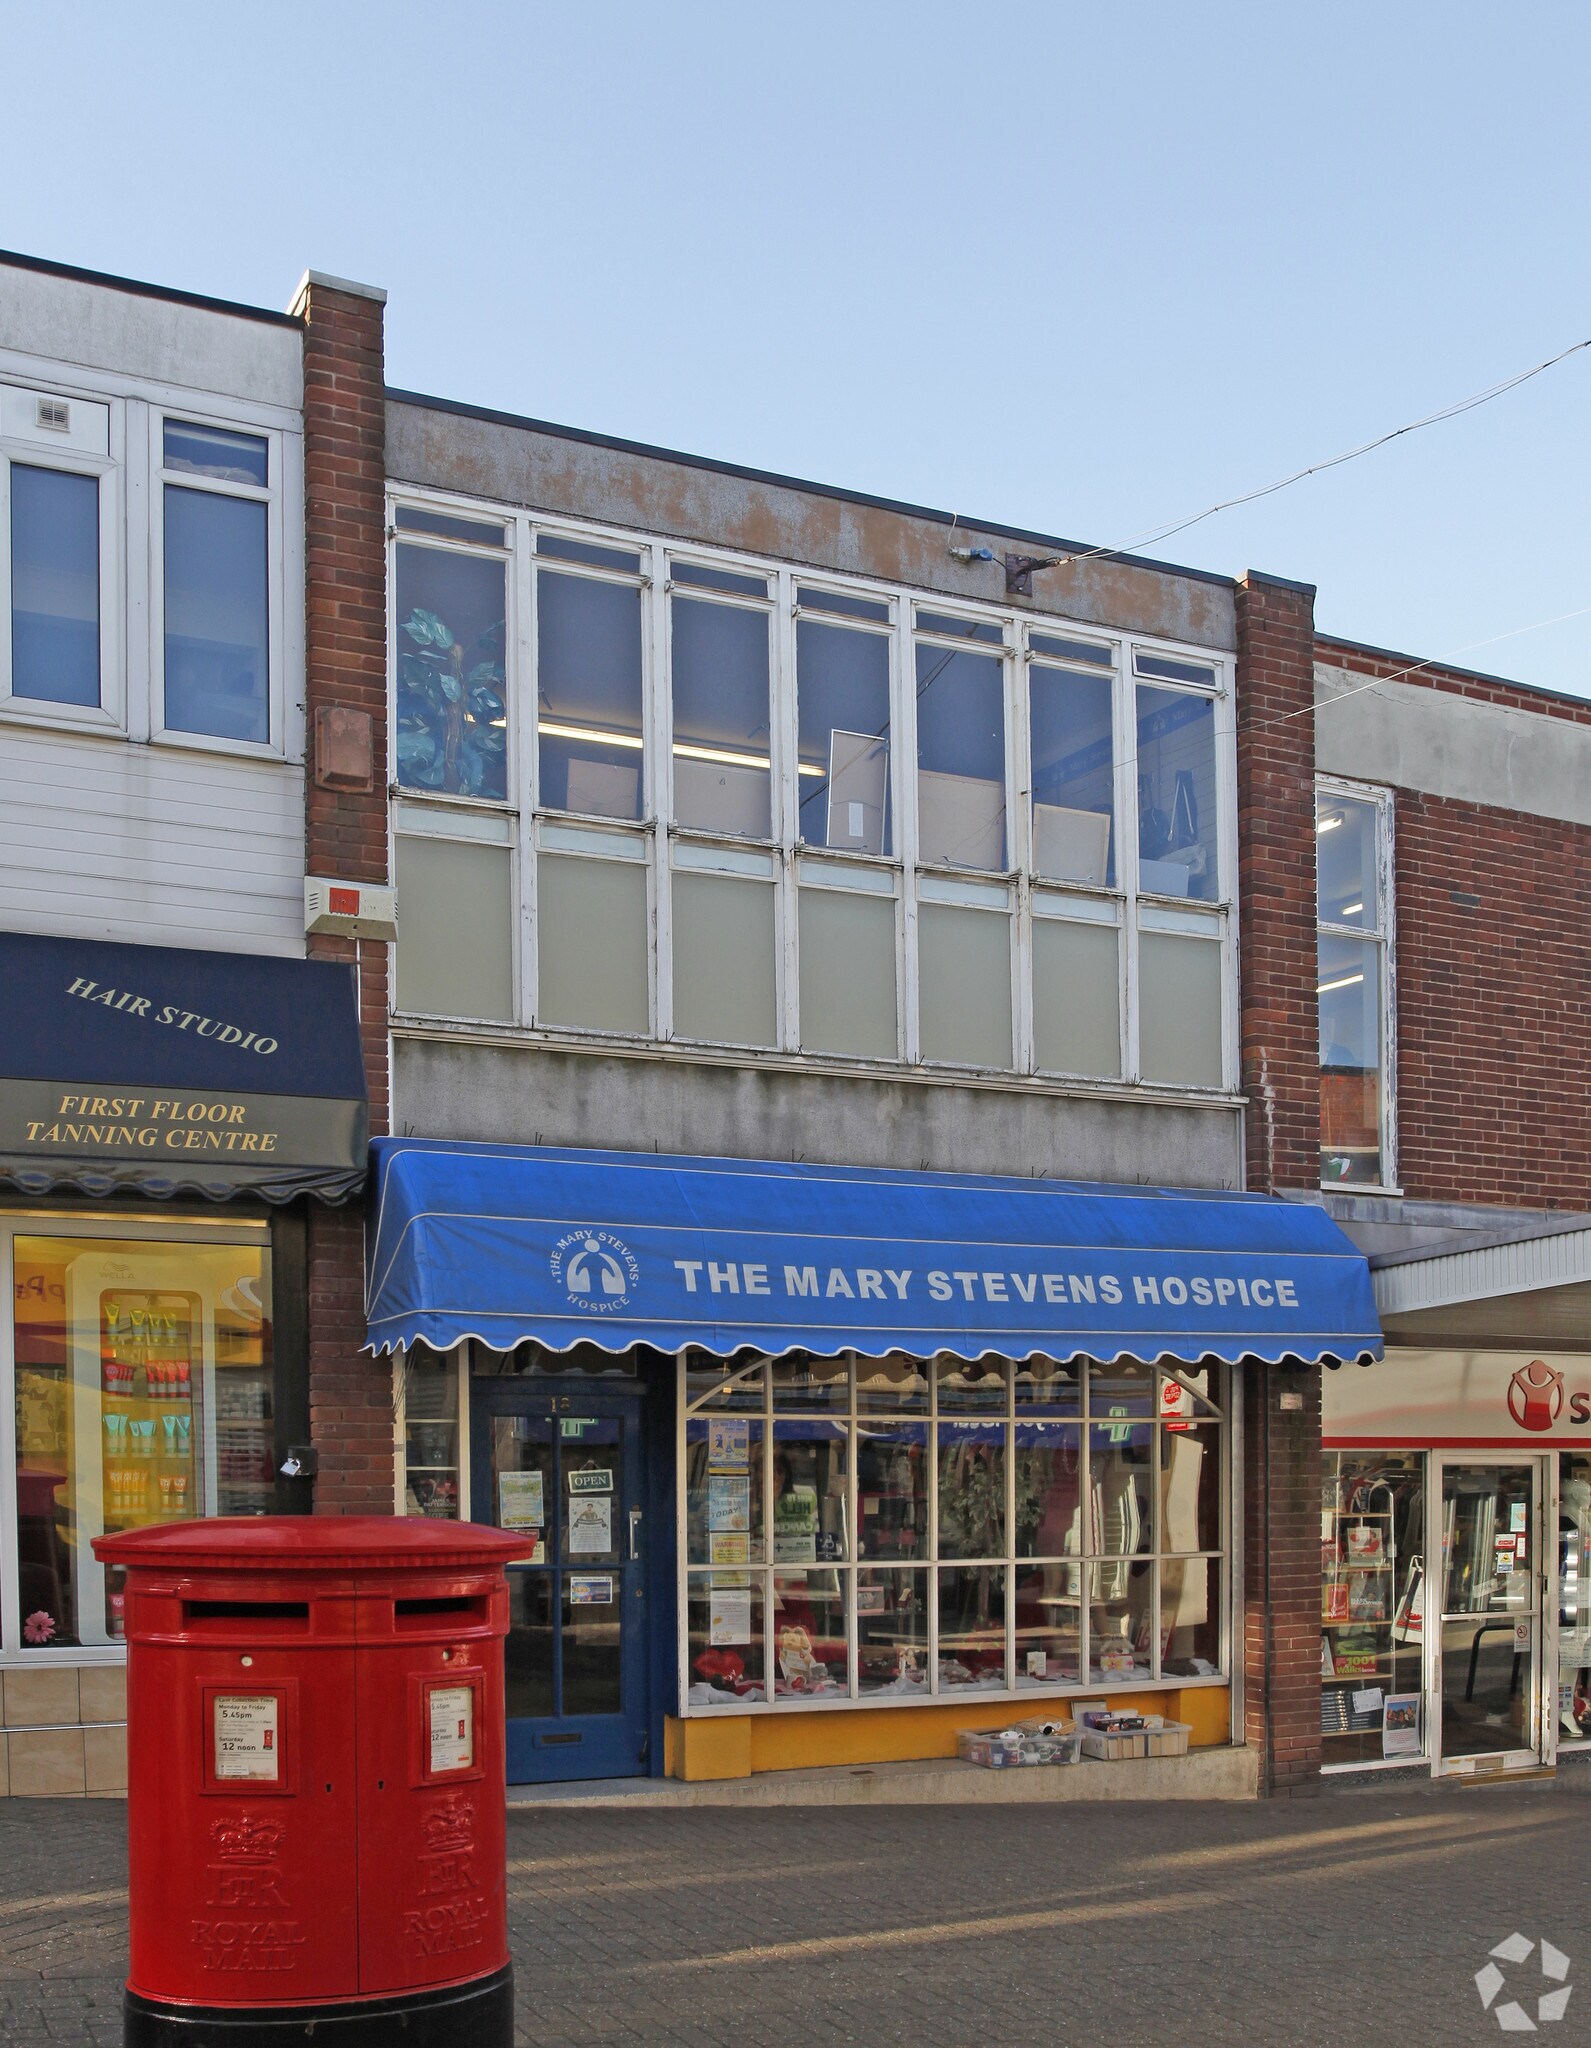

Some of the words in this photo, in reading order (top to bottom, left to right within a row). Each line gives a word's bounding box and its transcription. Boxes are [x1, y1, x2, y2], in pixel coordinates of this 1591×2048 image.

[65, 977, 152, 1018] HAIR
[155, 1005, 278, 1055] STUDIO
[58, 1095, 144, 1118] FIRST
[150, 1100, 246, 1124] FLOOR
[26, 1122, 158, 1147] TANNING
[166, 1128, 278, 1152] CENTRE
[550, 1251, 562, 1277] THE
[556, 1230, 593, 1250] MARY
[598, 1232, 639, 1281] STEVENS
[673, 1260, 771, 1295] THE
[783, 1265, 912, 1300] MARY
[927, 1270, 1123, 1305] STEVENS
[1132, 1276, 1299, 1307] HOSPICE
[567, 1293, 630, 1312] HOSPICE
[574, 1475, 607, 1487] OPEN
[1337, 1665, 1361, 1674] Walks
[1346, 1655, 1376, 1666] 1001
[222, 1742, 235, 1750] 12
[191, 1919, 307, 1945] ROYAL
[203, 1947, 296, 1971] MAIL
